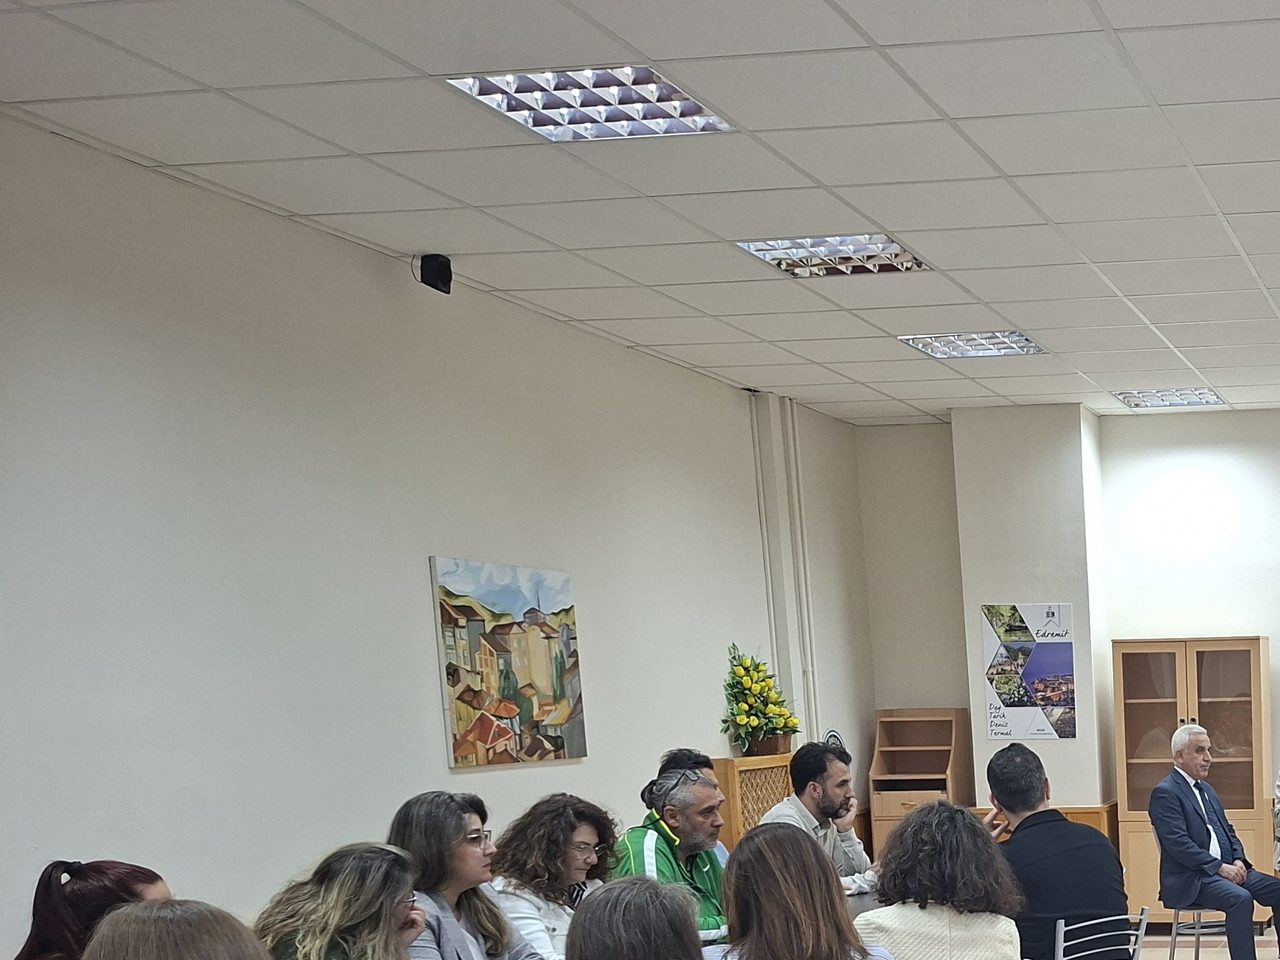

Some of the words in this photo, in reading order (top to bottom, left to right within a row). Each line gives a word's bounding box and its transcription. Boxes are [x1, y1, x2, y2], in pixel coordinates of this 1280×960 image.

[1035, 629, 1069, 639] Edremit
[990, 720, 1008, 728] Deniz
[990, 729, 1012, 737] Termal
